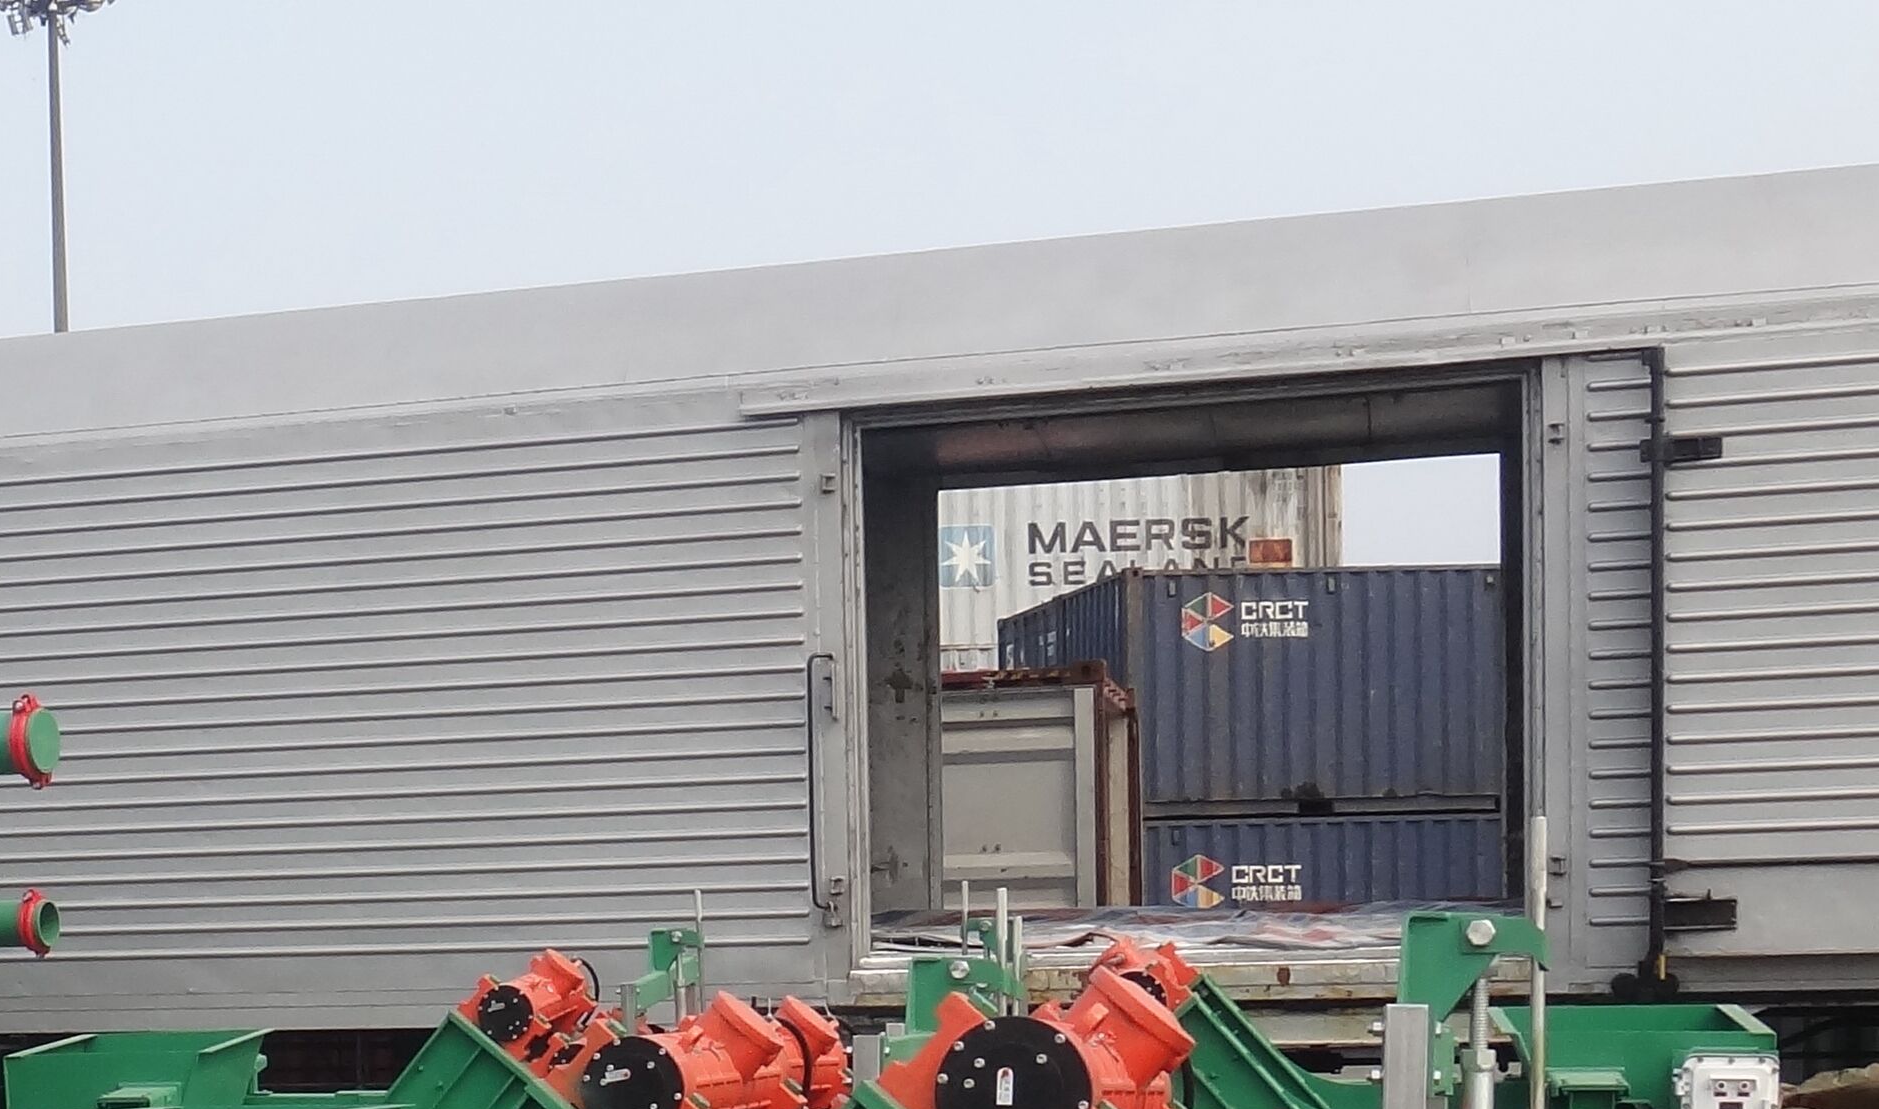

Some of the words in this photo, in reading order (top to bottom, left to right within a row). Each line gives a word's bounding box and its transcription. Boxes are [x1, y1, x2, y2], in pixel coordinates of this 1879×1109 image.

[1027, 516, 1249, 554] MAERSK
[1241, 601, 1309, 619] CRCT
[1232, 865, 1302, 883] CRCT
